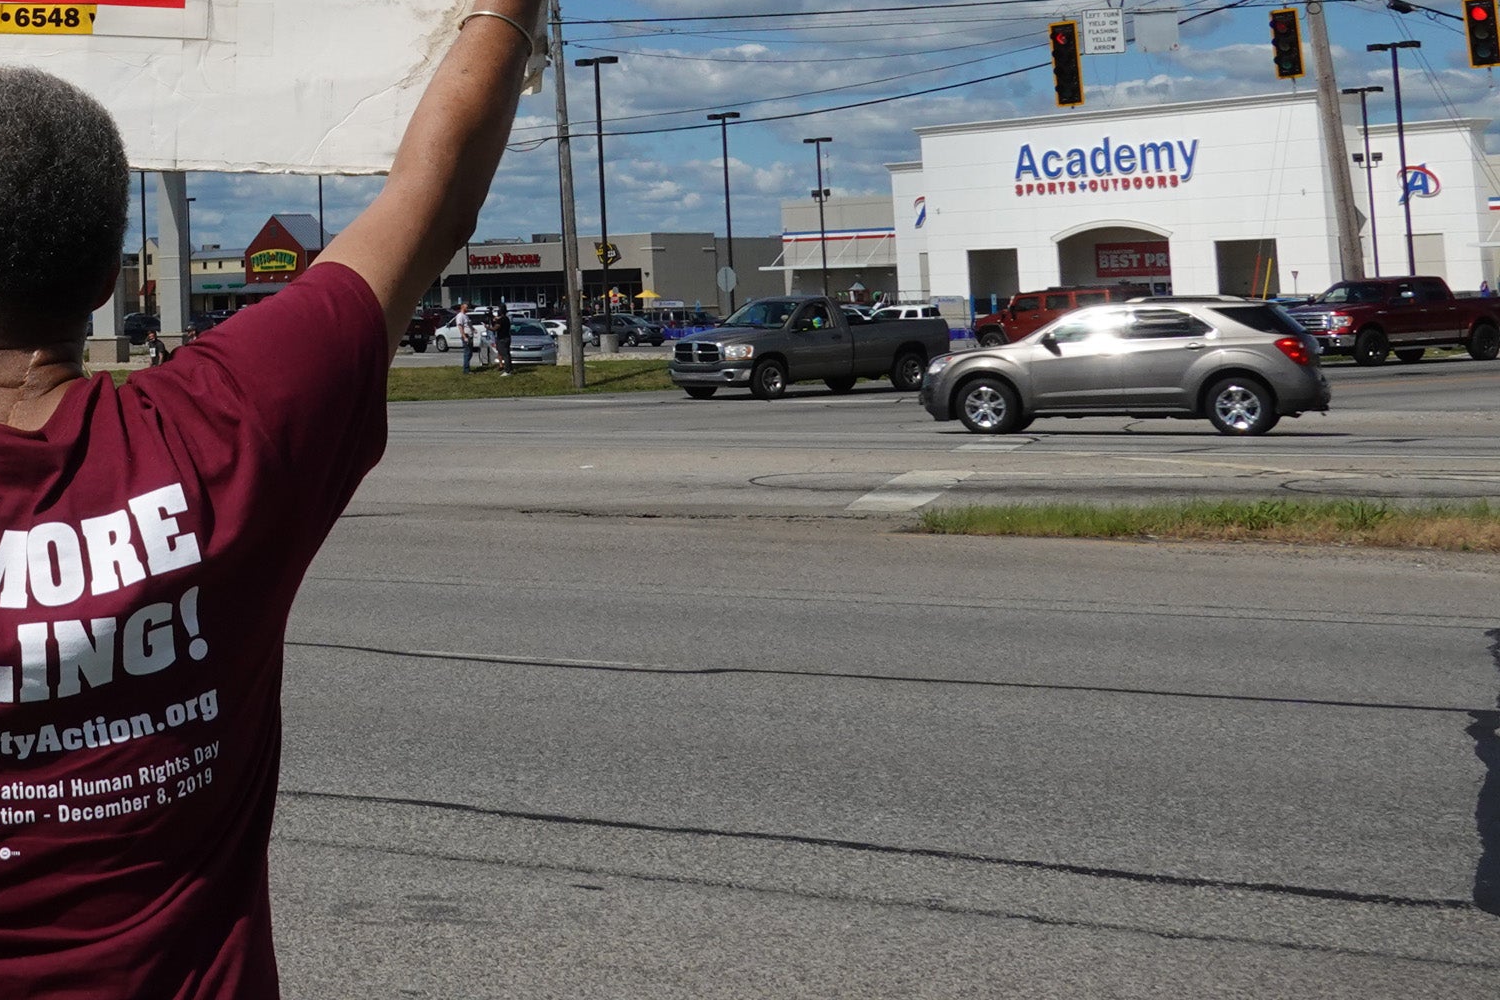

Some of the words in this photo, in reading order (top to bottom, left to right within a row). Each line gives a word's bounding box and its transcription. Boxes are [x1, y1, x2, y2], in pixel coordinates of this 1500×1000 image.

[1086, 10, 1101, 18] LEFT
[1015, 136, 1199, 182] Academy
[1099, 254, 1140, 269] BEST
[1145, 253, 1168, 267] PR
[71, 774, 133, 798] Human
[139, 756, 191, 787] Rights
[194, 740, 221, 769] Day
[57, 791, 151, 823] December
[156, 786, 173, 808] 8,
[177, 767, 215, 799] 2019
